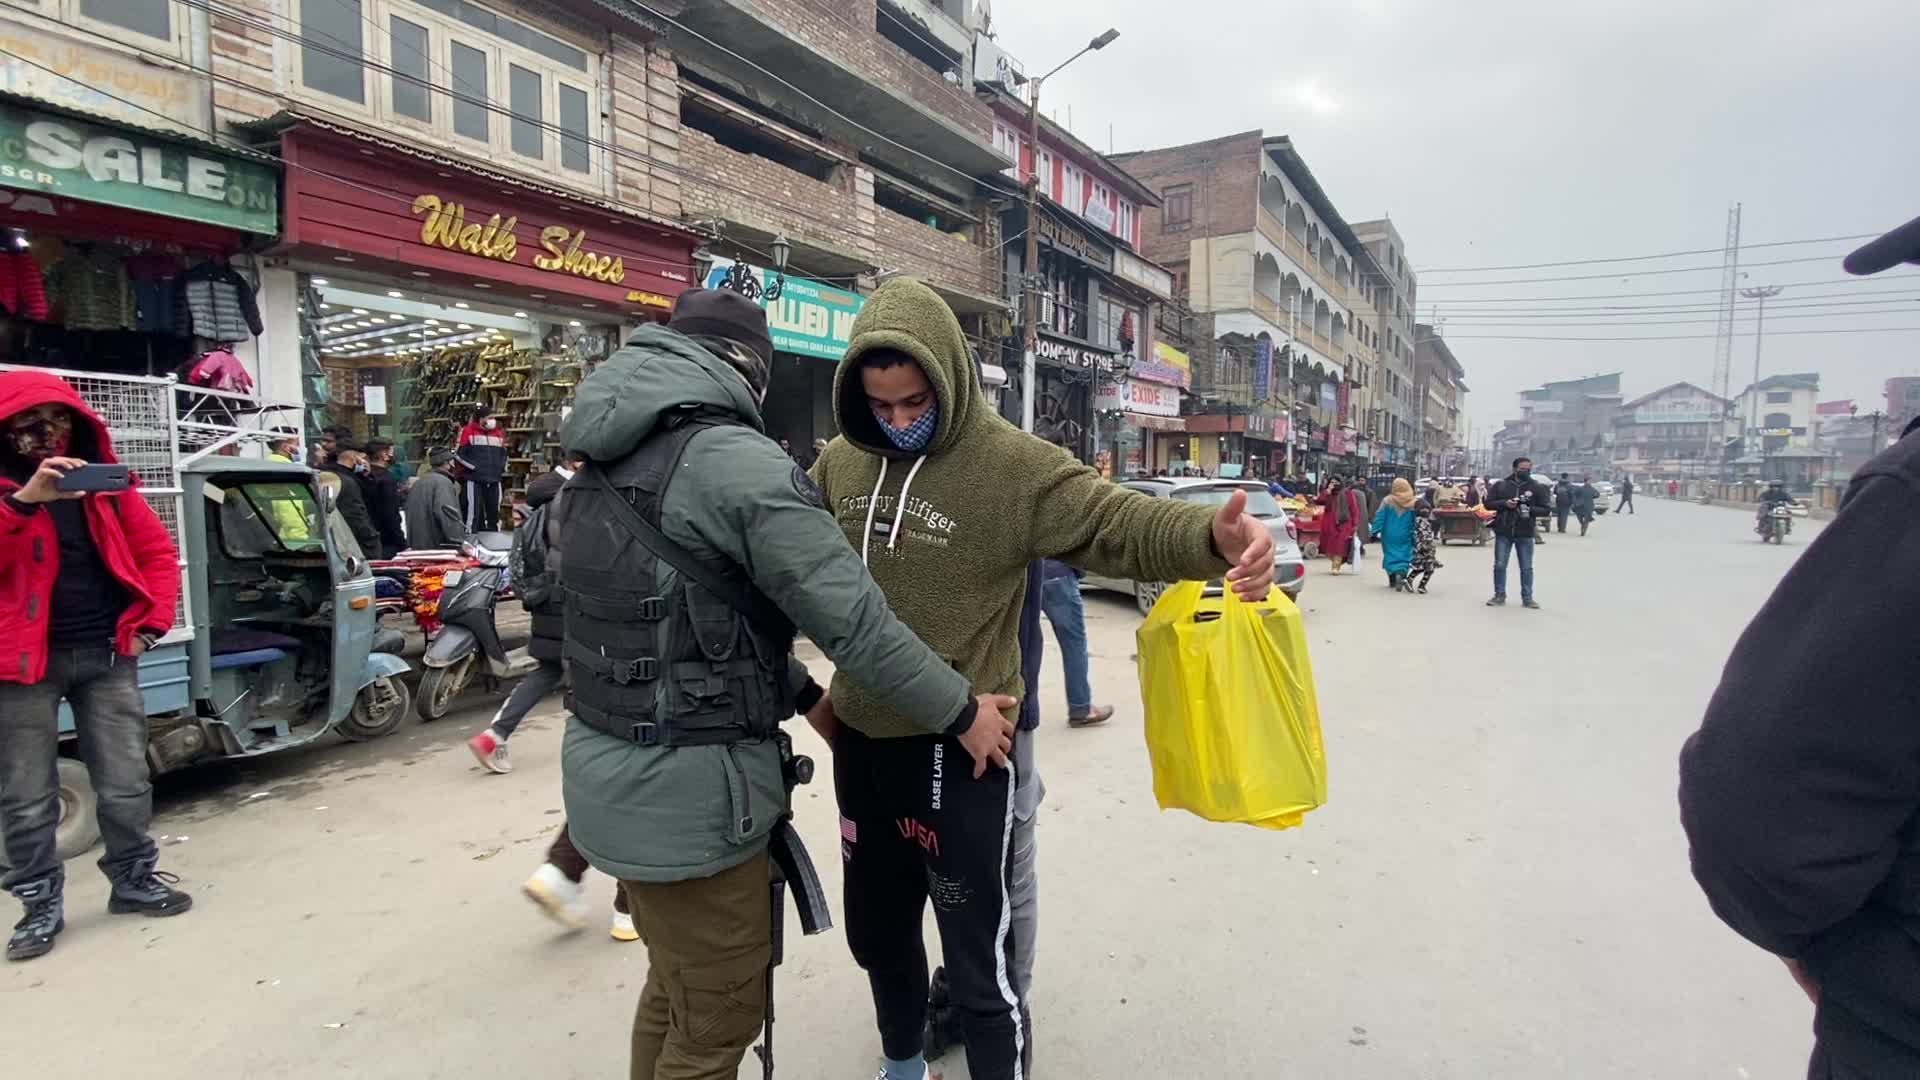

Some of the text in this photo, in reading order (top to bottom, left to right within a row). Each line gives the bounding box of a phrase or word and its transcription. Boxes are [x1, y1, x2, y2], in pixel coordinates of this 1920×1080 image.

[25, 121, 226, 201] SALE
[412, 194, 624, 284] Walk Shoes
[767, 296, 829, 338] ALLIED
[1082, 351, 1114, 372] STORE
[1131, 383, 1160, 405] EXIDE
[932, 743, 943, 810] BASE LAYER
